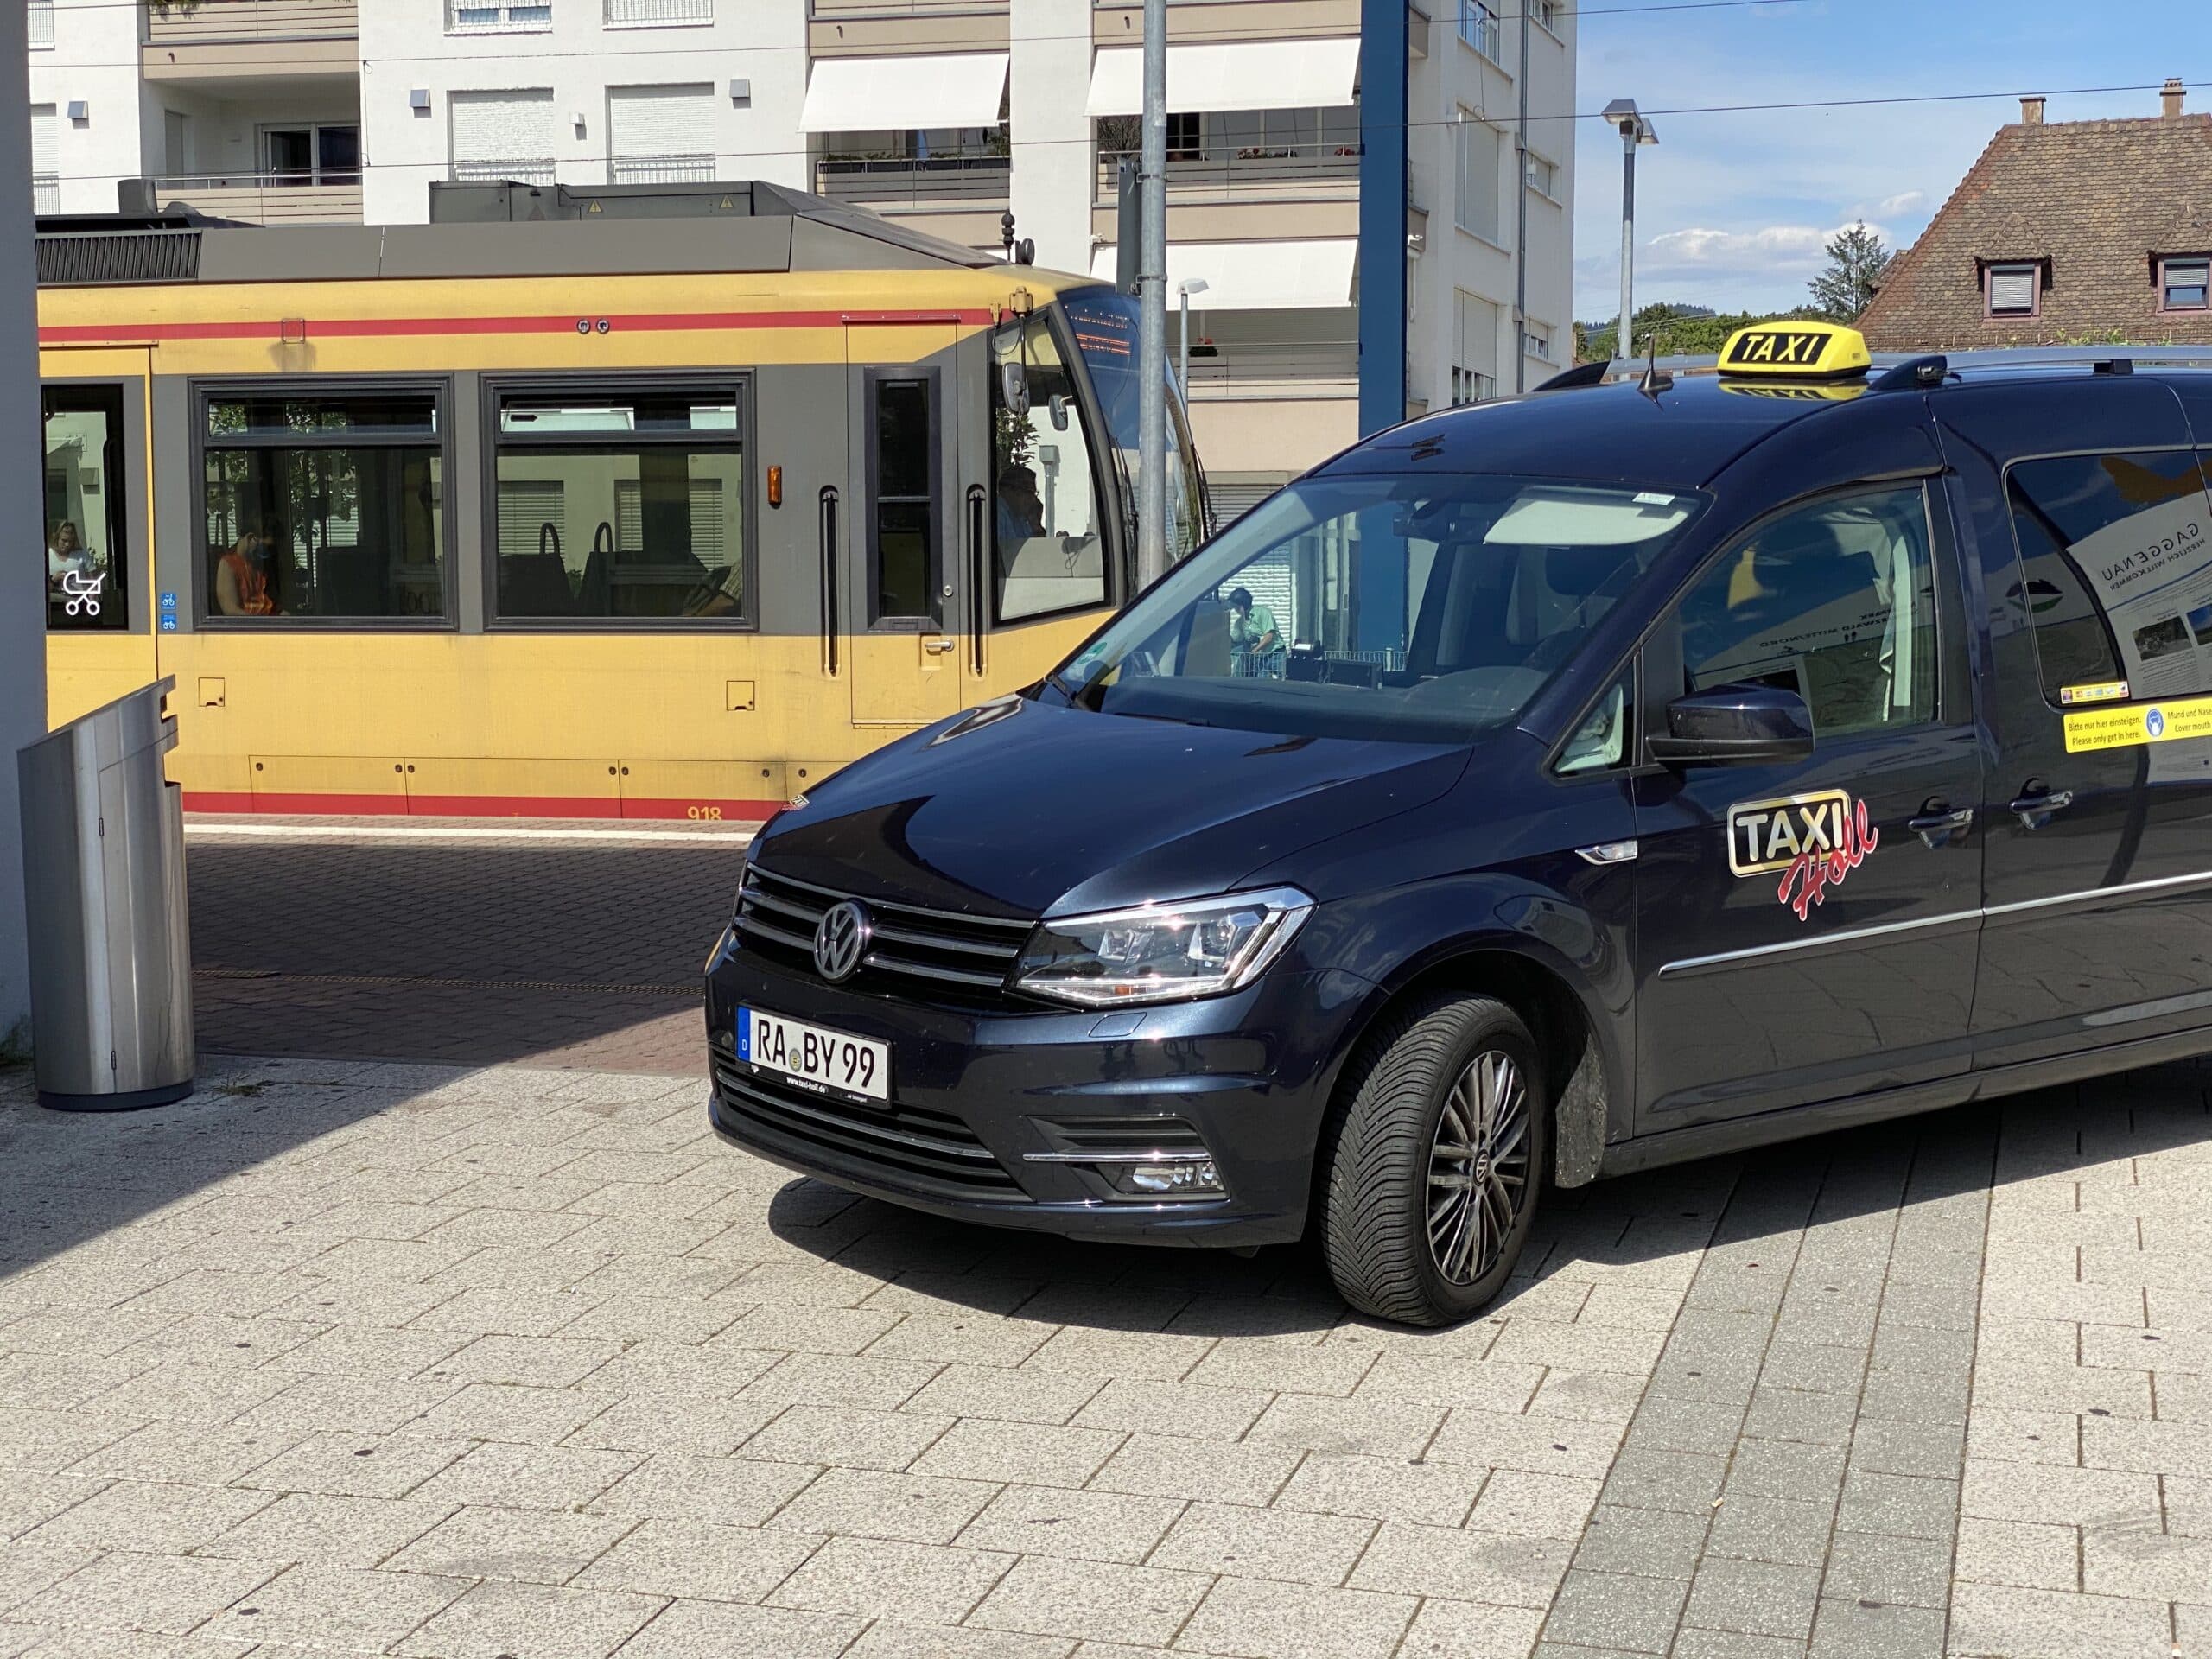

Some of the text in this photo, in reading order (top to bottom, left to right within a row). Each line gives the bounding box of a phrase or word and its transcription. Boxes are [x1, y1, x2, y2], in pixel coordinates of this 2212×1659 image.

[1741, 335, 1820, 361] TAXI
[2167, 709, 2185, 719] Mund
[2186, 709, 2197, 717] und
[2069, 721, 2083, 732] Bitte
[2096, 719, 2108, 728] hier
[2175, 721, 2211, 733] Cover mouth
[2072, 735, 2092, 746] Please
[2093, 733, 2107, 744] only
[2107, 734, 2117, 743] get
[2125, 730, 2140, 740] here.
[687, 806, 722, 821] 918
[1736, 802, 1845, 862] TAXI
[1777, 799, 1878, 922] Holl
[757, 1019, 874, 1089] RA BY 99
